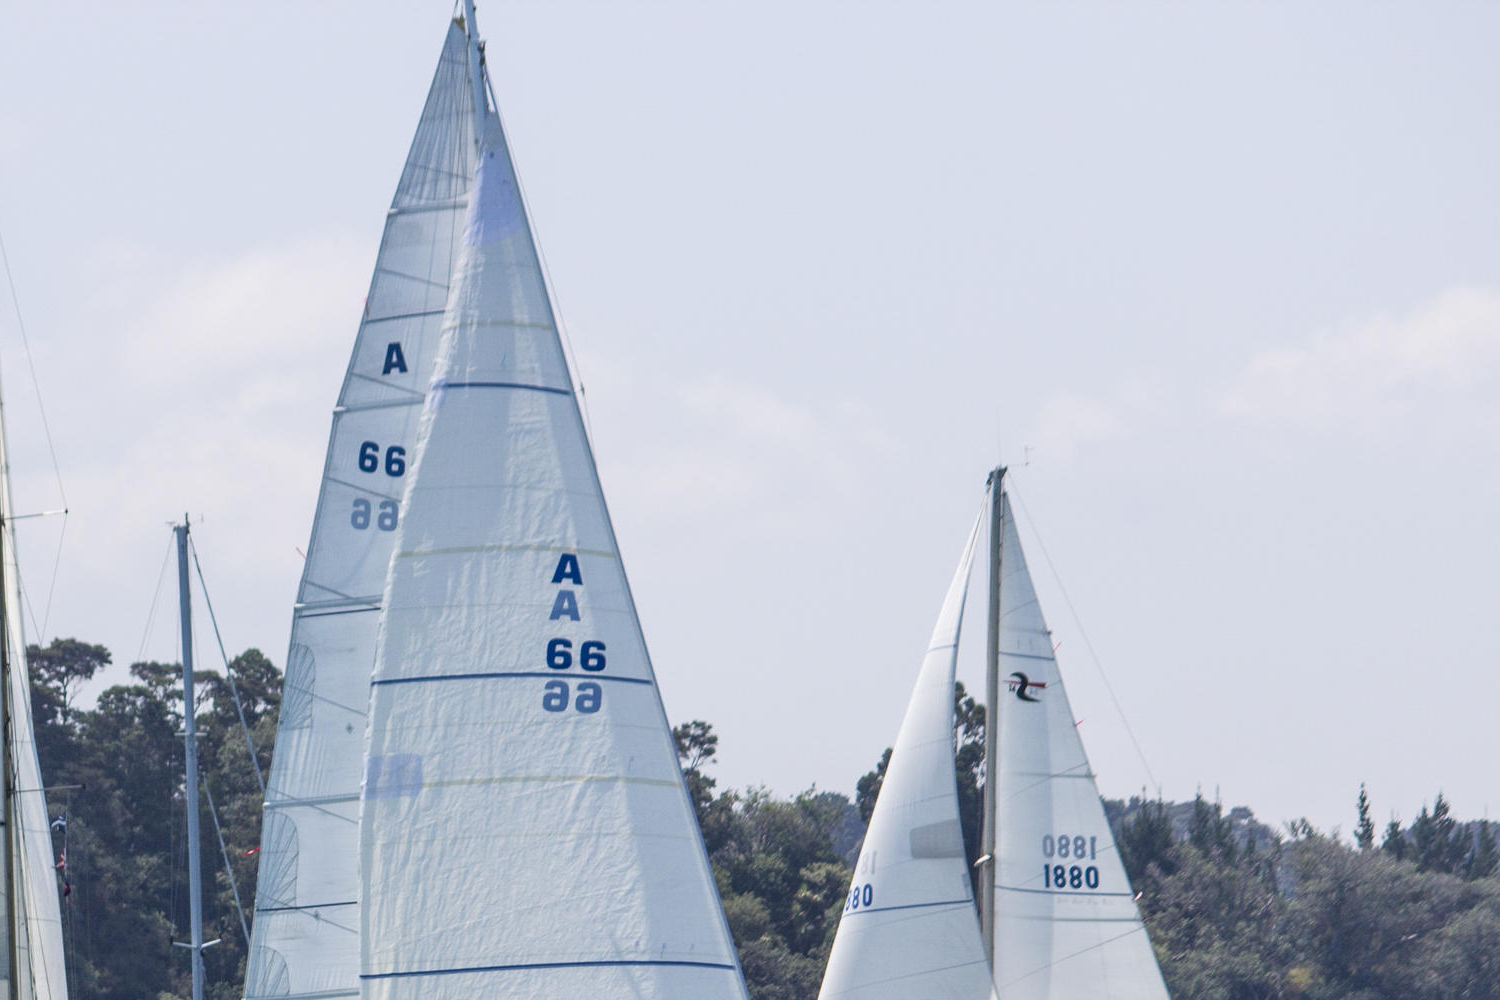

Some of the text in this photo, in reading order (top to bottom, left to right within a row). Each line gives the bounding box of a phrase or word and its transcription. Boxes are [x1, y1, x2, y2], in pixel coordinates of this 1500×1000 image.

[382, 342, 409, 375] A
[358, 441, 406, 478] 66
[551, 552, 583, 585] A
[545, 637, 607, 672] 66
[1044, 864, 1099, 889] 1880
